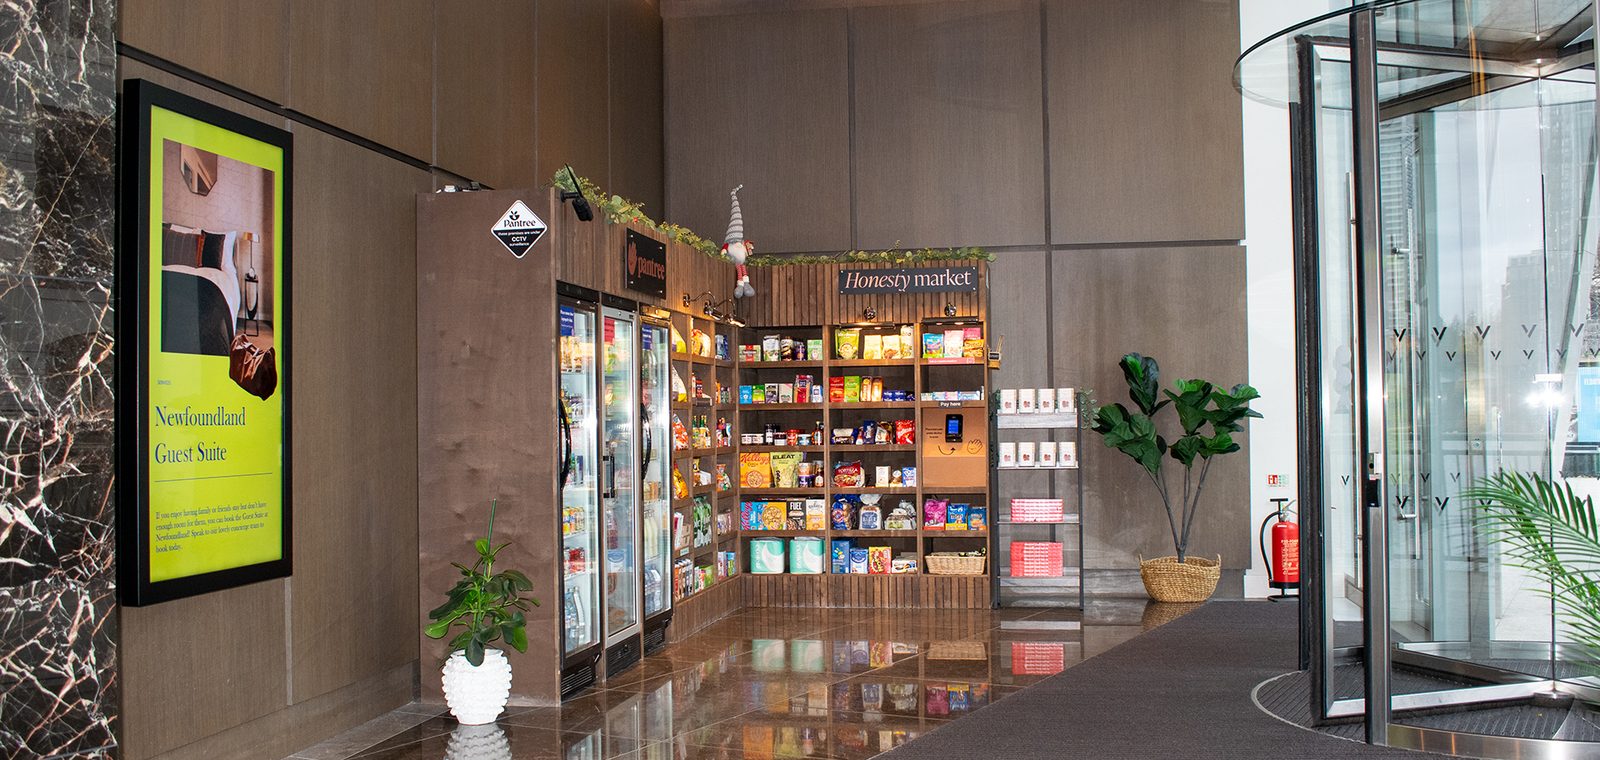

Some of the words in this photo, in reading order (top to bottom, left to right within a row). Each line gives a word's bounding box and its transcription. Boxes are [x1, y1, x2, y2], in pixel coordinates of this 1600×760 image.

[504, 220, 536, 228] Pantree
[638, 256, 665, 280] pantree
[844, 272, 911, 292] Honesty
[914, 269, 972, 287] market
[155, 406, 246, 428] Newfoundland
[155, 442, 193, 464] Guest
[197, 441, 227, 462] Suite
[790, 502, 802, 510] FUEL
[224, 514, 234, 522] book
[242, 512, 254, 520] Guest
[191, 528, 204, 538] Speak
[156, 544, 168, 553] book
